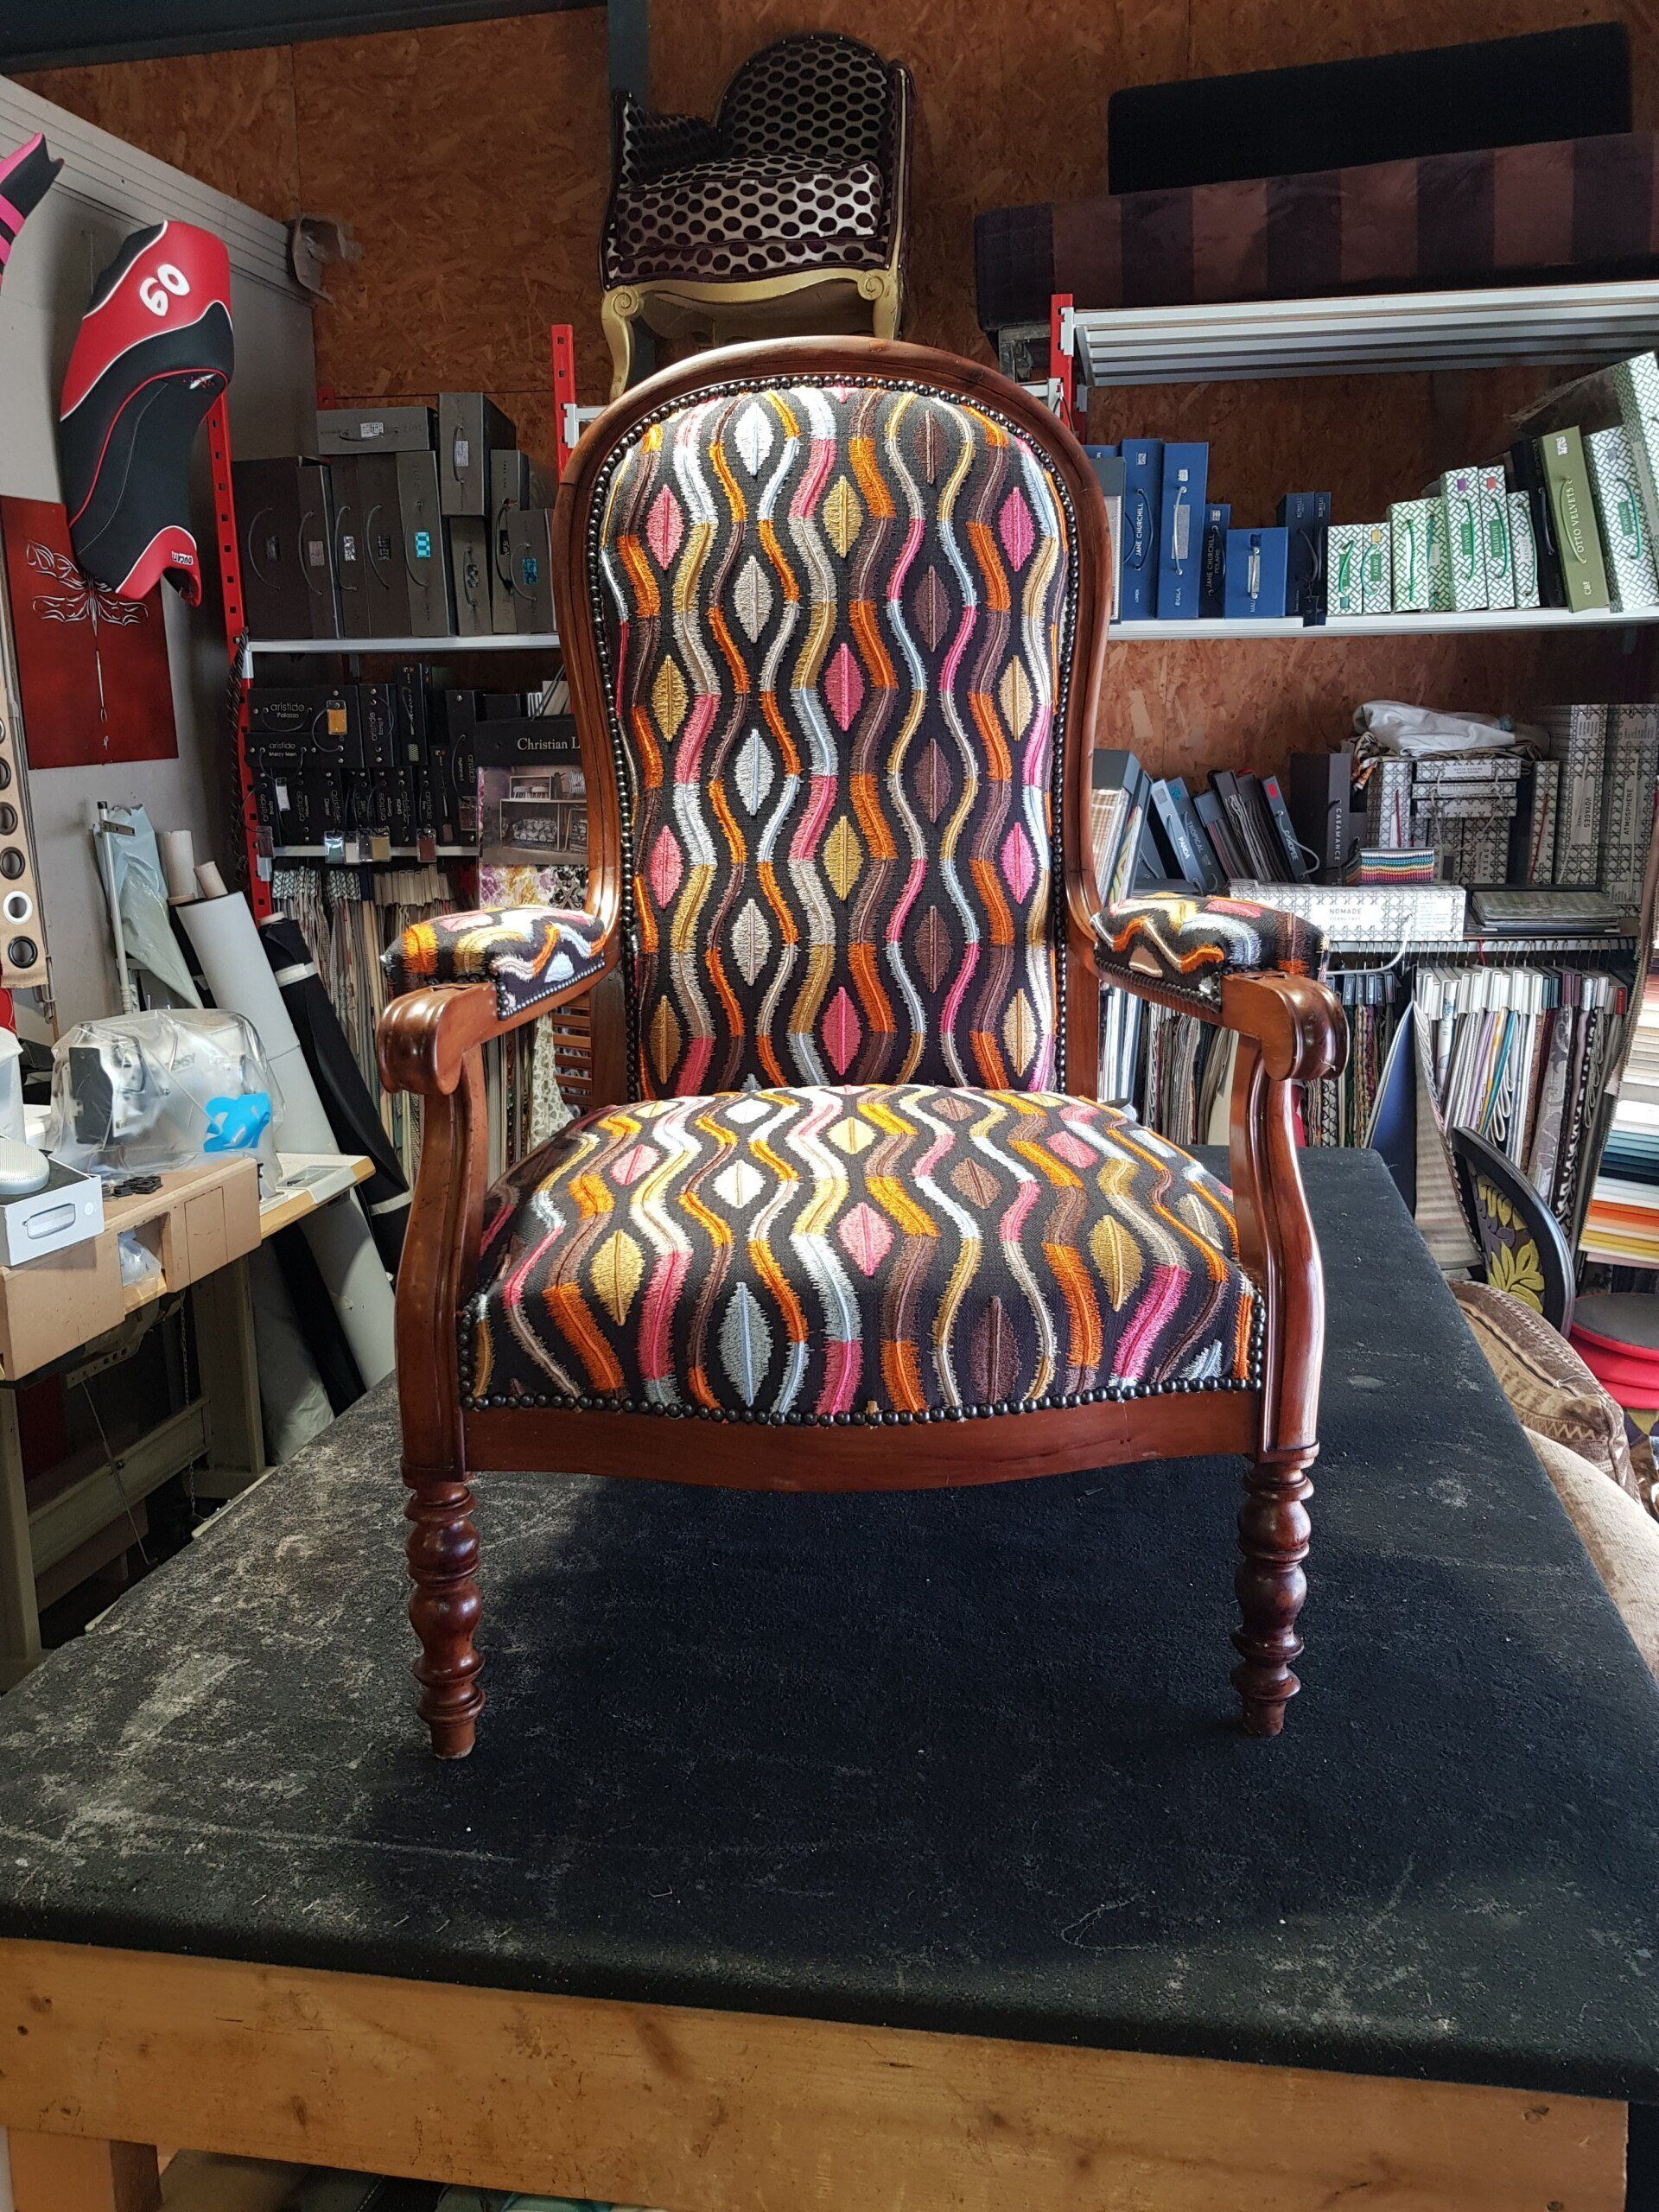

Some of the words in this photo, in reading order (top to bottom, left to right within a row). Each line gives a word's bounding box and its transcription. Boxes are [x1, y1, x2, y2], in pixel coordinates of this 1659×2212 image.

[139, 264, 191, 316] 60
[1566, 487, 1580, 526] VELVETS
[1573, 528, 1585, 553] OTTO
[172, 553, 192, 565] DUCATI
[270, 702, 305, 712] aristide
[368, 711, 378, 741] aristide
[269, 741, 296, 749] aristide
[517, 737, 568, 750] Christian
[467, 753, 476, 785] aristide
[258, 793, 270, 823] aristide
[296, 790, 306, 823] aristide
[378, 792, 386, 821] aristide
[1624, 787, 1634, 836] ATMOSPHERE
[1178, 836, 1191, 860] PANDA
[1186, 820, 1204, 854] TROPICAL
[1334, 807, 1343, 861] CASAMANCE
